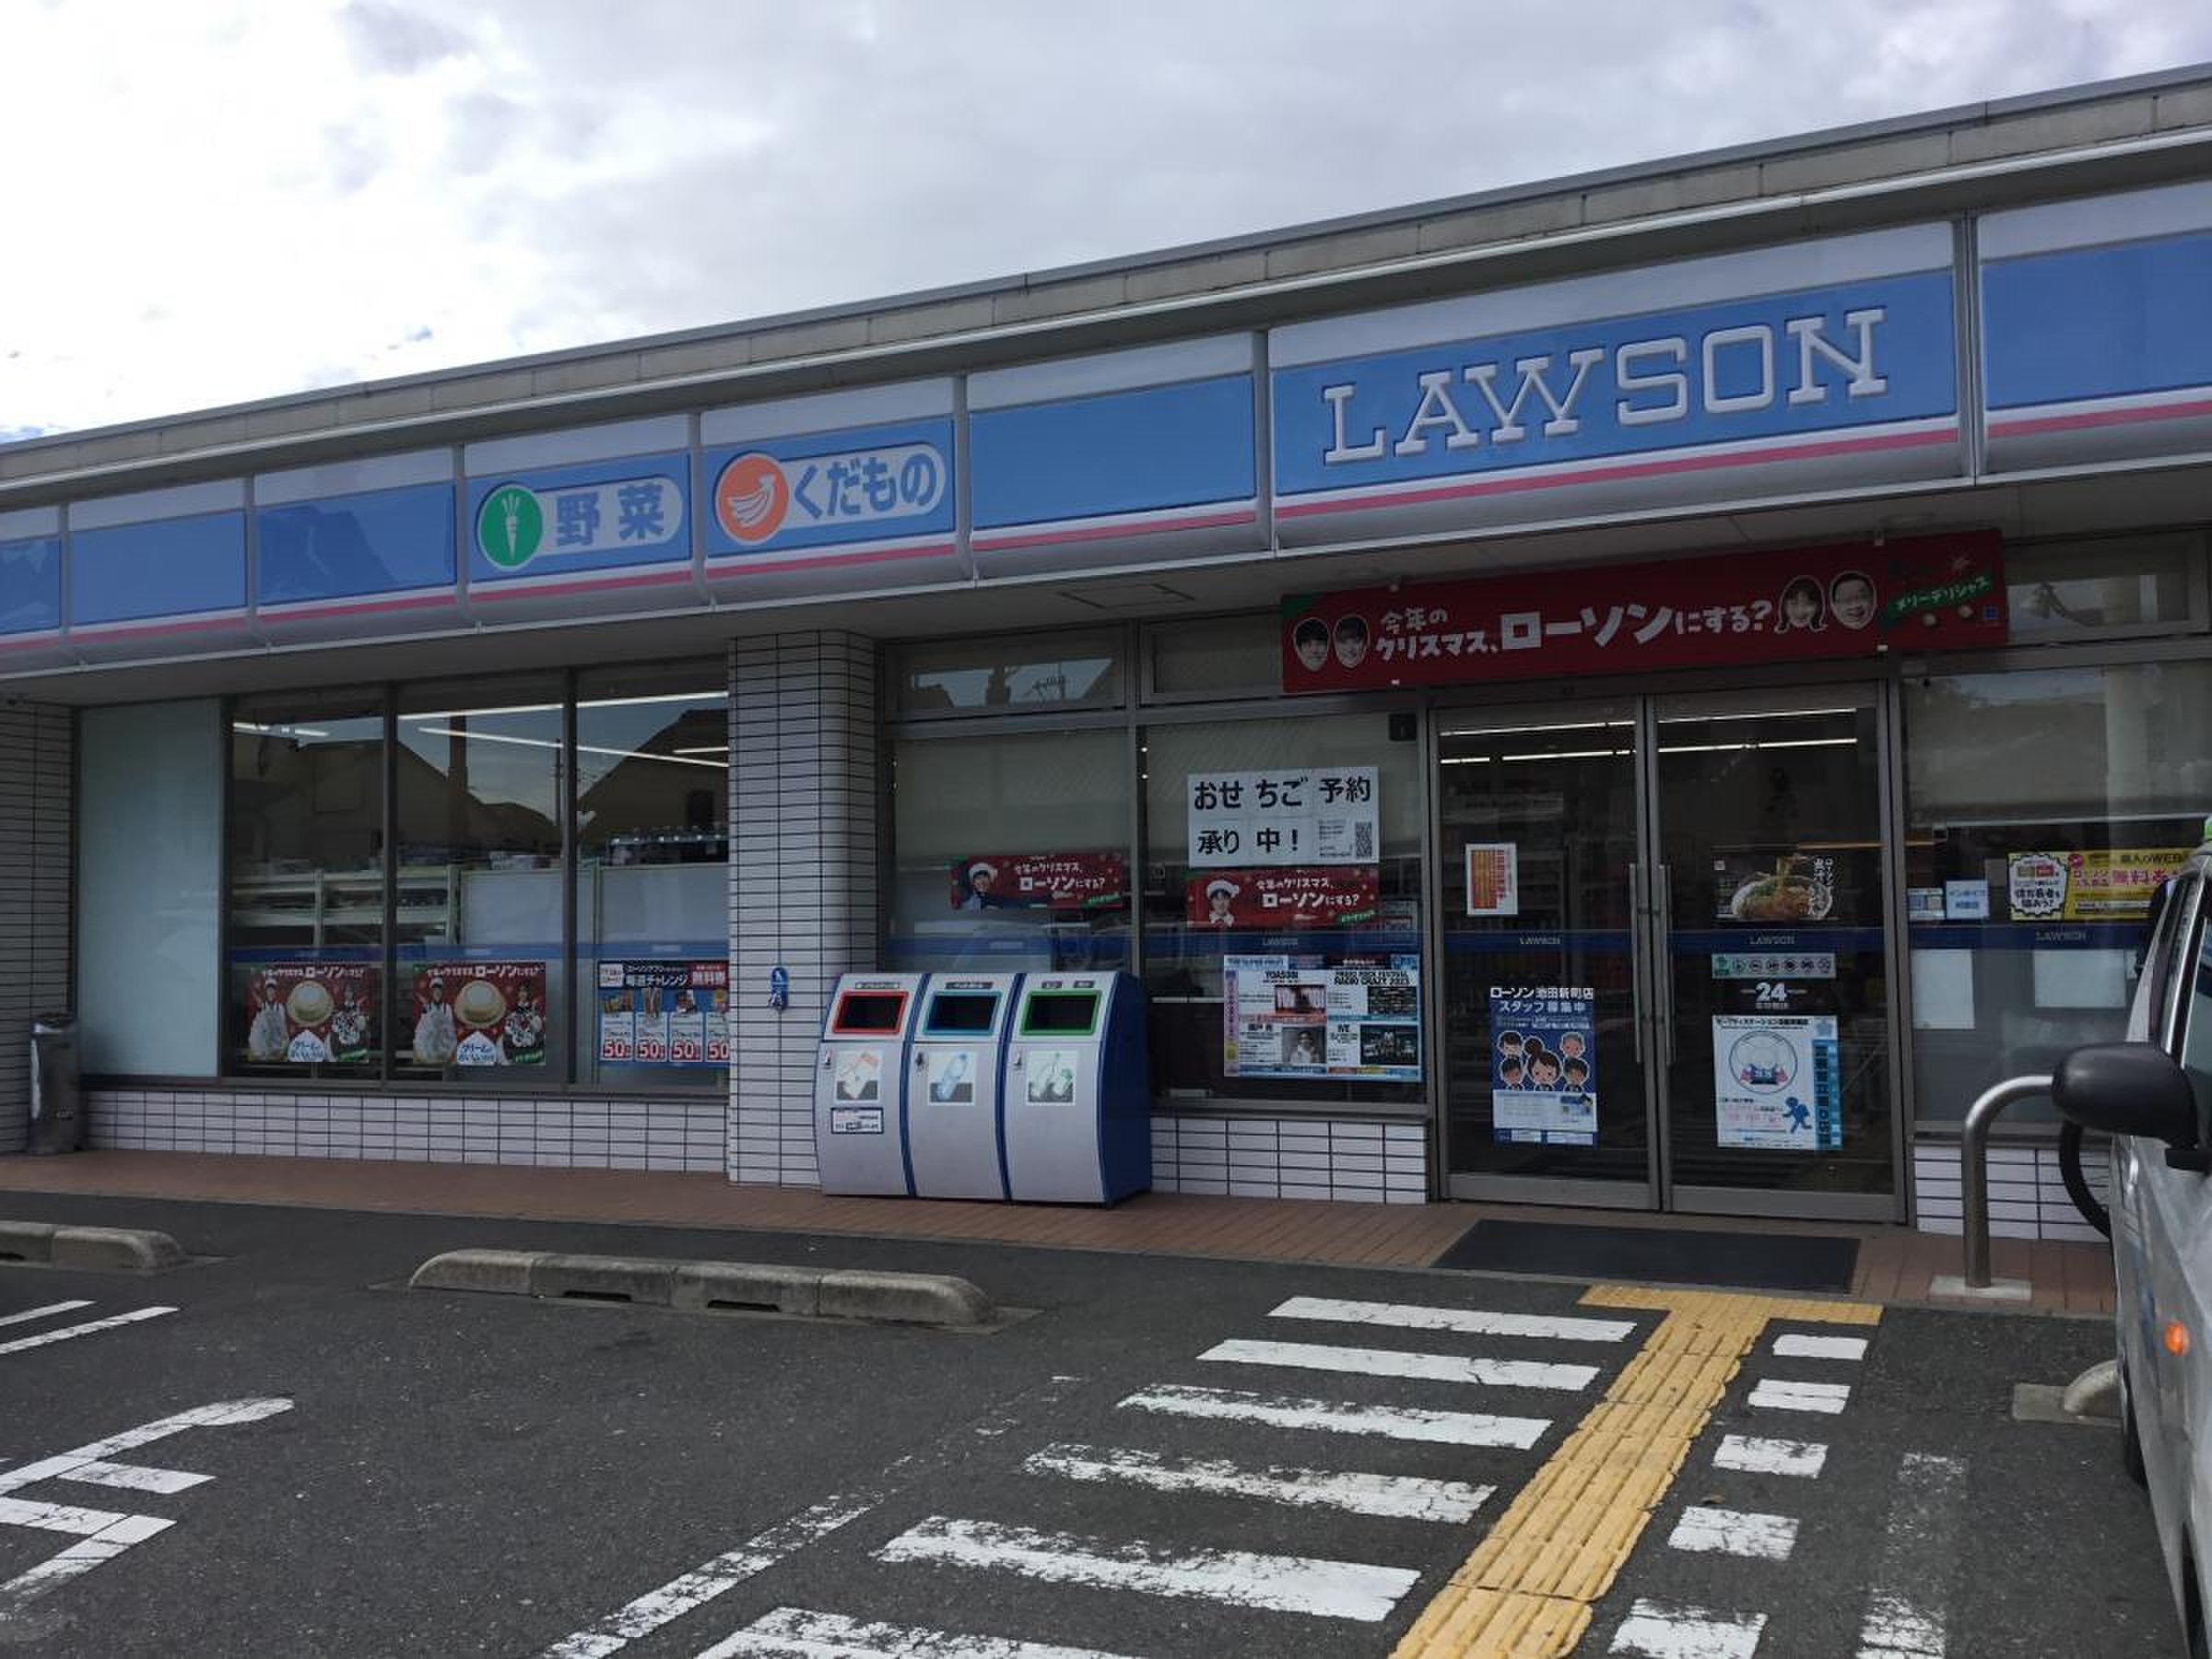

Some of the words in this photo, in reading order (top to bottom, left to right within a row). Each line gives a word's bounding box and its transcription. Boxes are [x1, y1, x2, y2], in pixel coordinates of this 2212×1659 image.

[1323, 308, 1887, 464] LAWSON
[794, 453, 936, 519] くだもの
[556, 482, 664, 547] 野菜
[1382, 606, 1449, 636] 今年の
[1319, 776, 1371, 804] 予約
[1748, 935, 1795, 945] LAWSON
[1755, 982, 1788, 1003] 24
